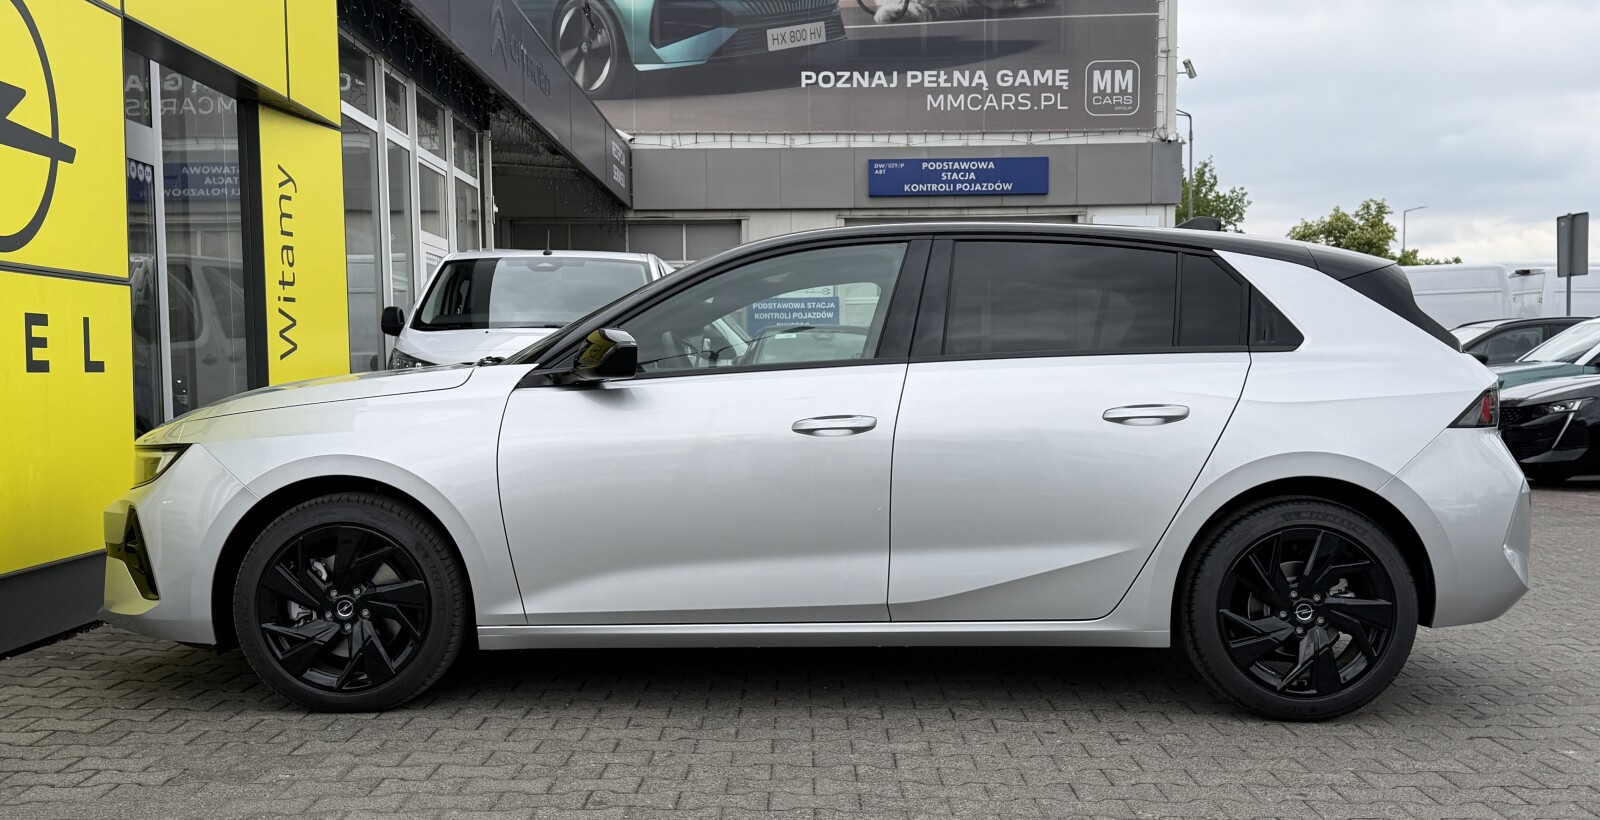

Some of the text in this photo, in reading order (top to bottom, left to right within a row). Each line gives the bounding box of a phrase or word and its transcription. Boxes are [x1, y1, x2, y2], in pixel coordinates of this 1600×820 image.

[771, 26, 822, 46] HX 800 HV
[800, 69, 1069, 90] POZNAJ PEŁNĄ GAMĘ
[1092, 69, 1133, 93] MM
[926, 93, 1069, 111] MMCARS.PL
[1092, 95, 1133, 105] CARS
[922, 161, 995, 170] PODSTAWOWA
[941, 172, 976, 180] STACJA
[904, 180, 1013, 192] KONTROLI POJAZDÓW
[277, 163, 298, 361] Witamy
[752, 302, 806, 310] PODSTAWOWA
[754, 311, 834, 320] KONTROLI POJAZDÓW
